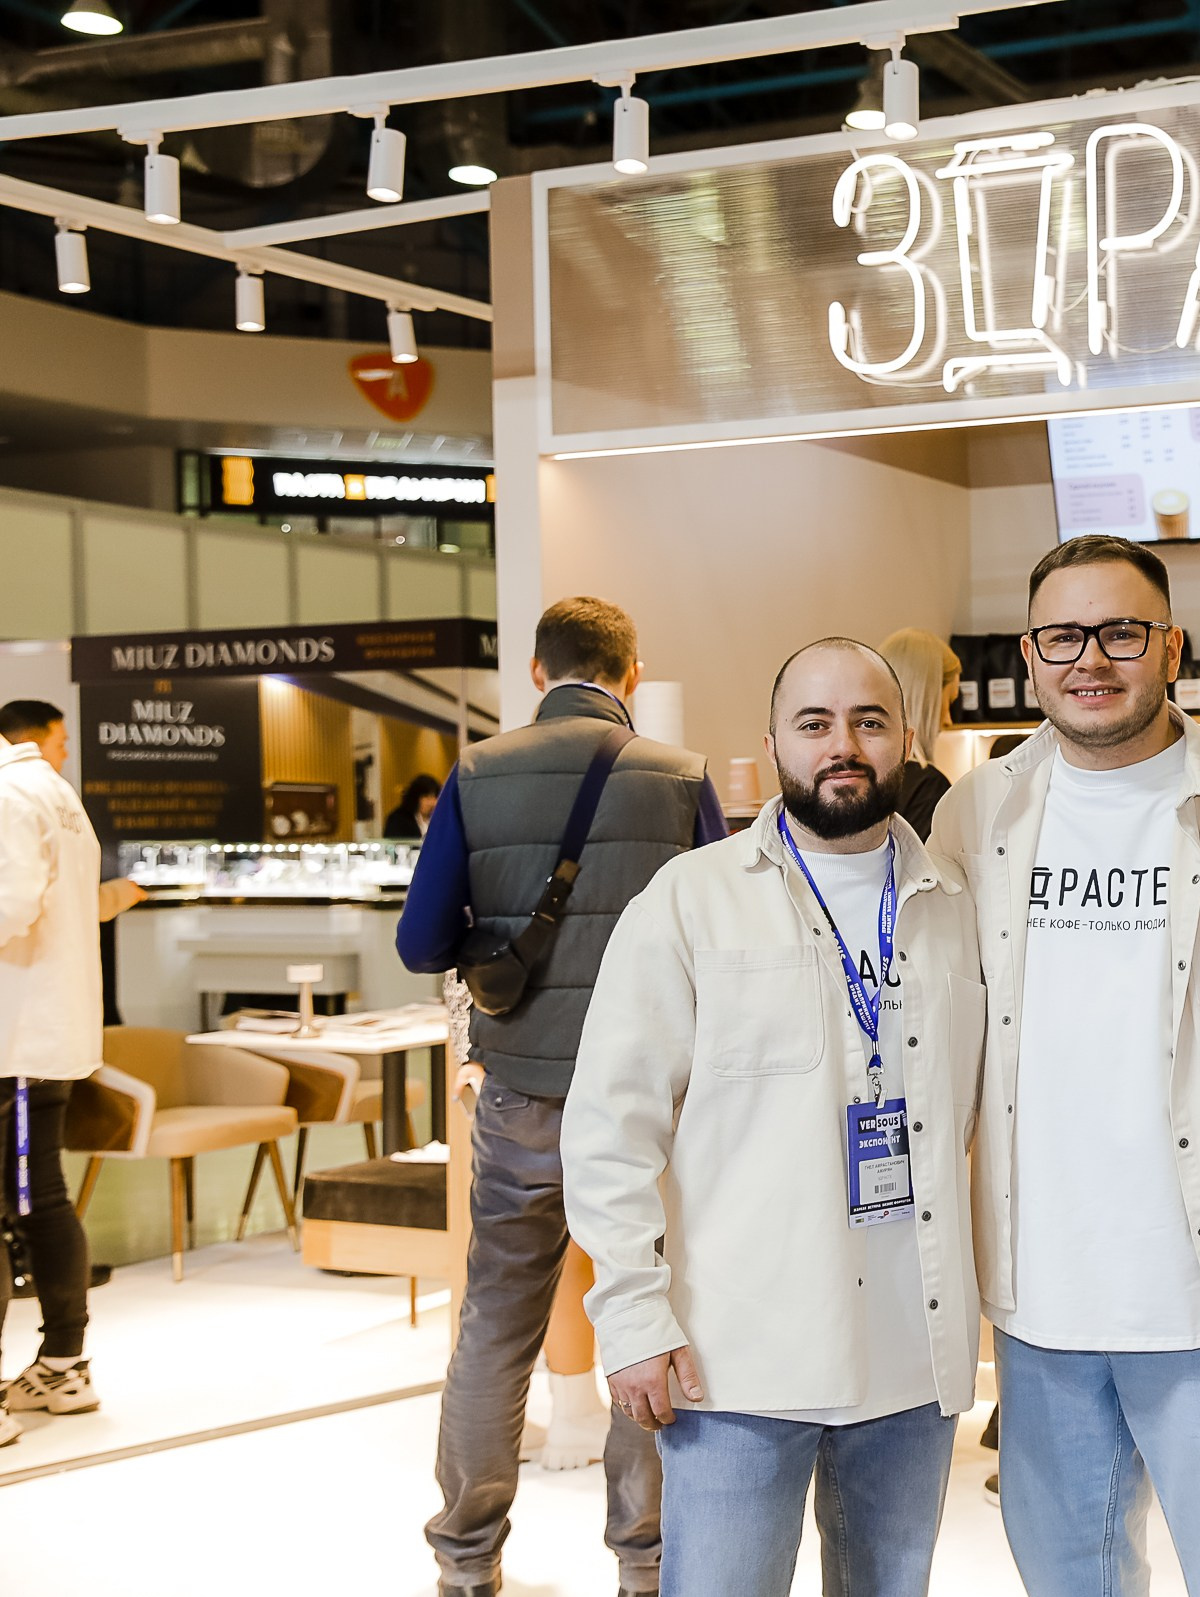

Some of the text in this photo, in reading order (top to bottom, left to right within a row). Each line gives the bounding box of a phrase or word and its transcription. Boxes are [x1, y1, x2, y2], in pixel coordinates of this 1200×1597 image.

[111, 637, 335, 671] MIUZ DIAMONDS
[132, 700, 194, 724] MIUZ
[99, 725, 225, 747] DIAMONDS
[1029, 867, 1170, 910] ДРАСТЕ
[1134, 918, 1166, 931] ЛЮДИ
[860, 1116, 899, 1131] VERSOUS
[859, 1135, 900, 1149] ЭКСПОННТ
